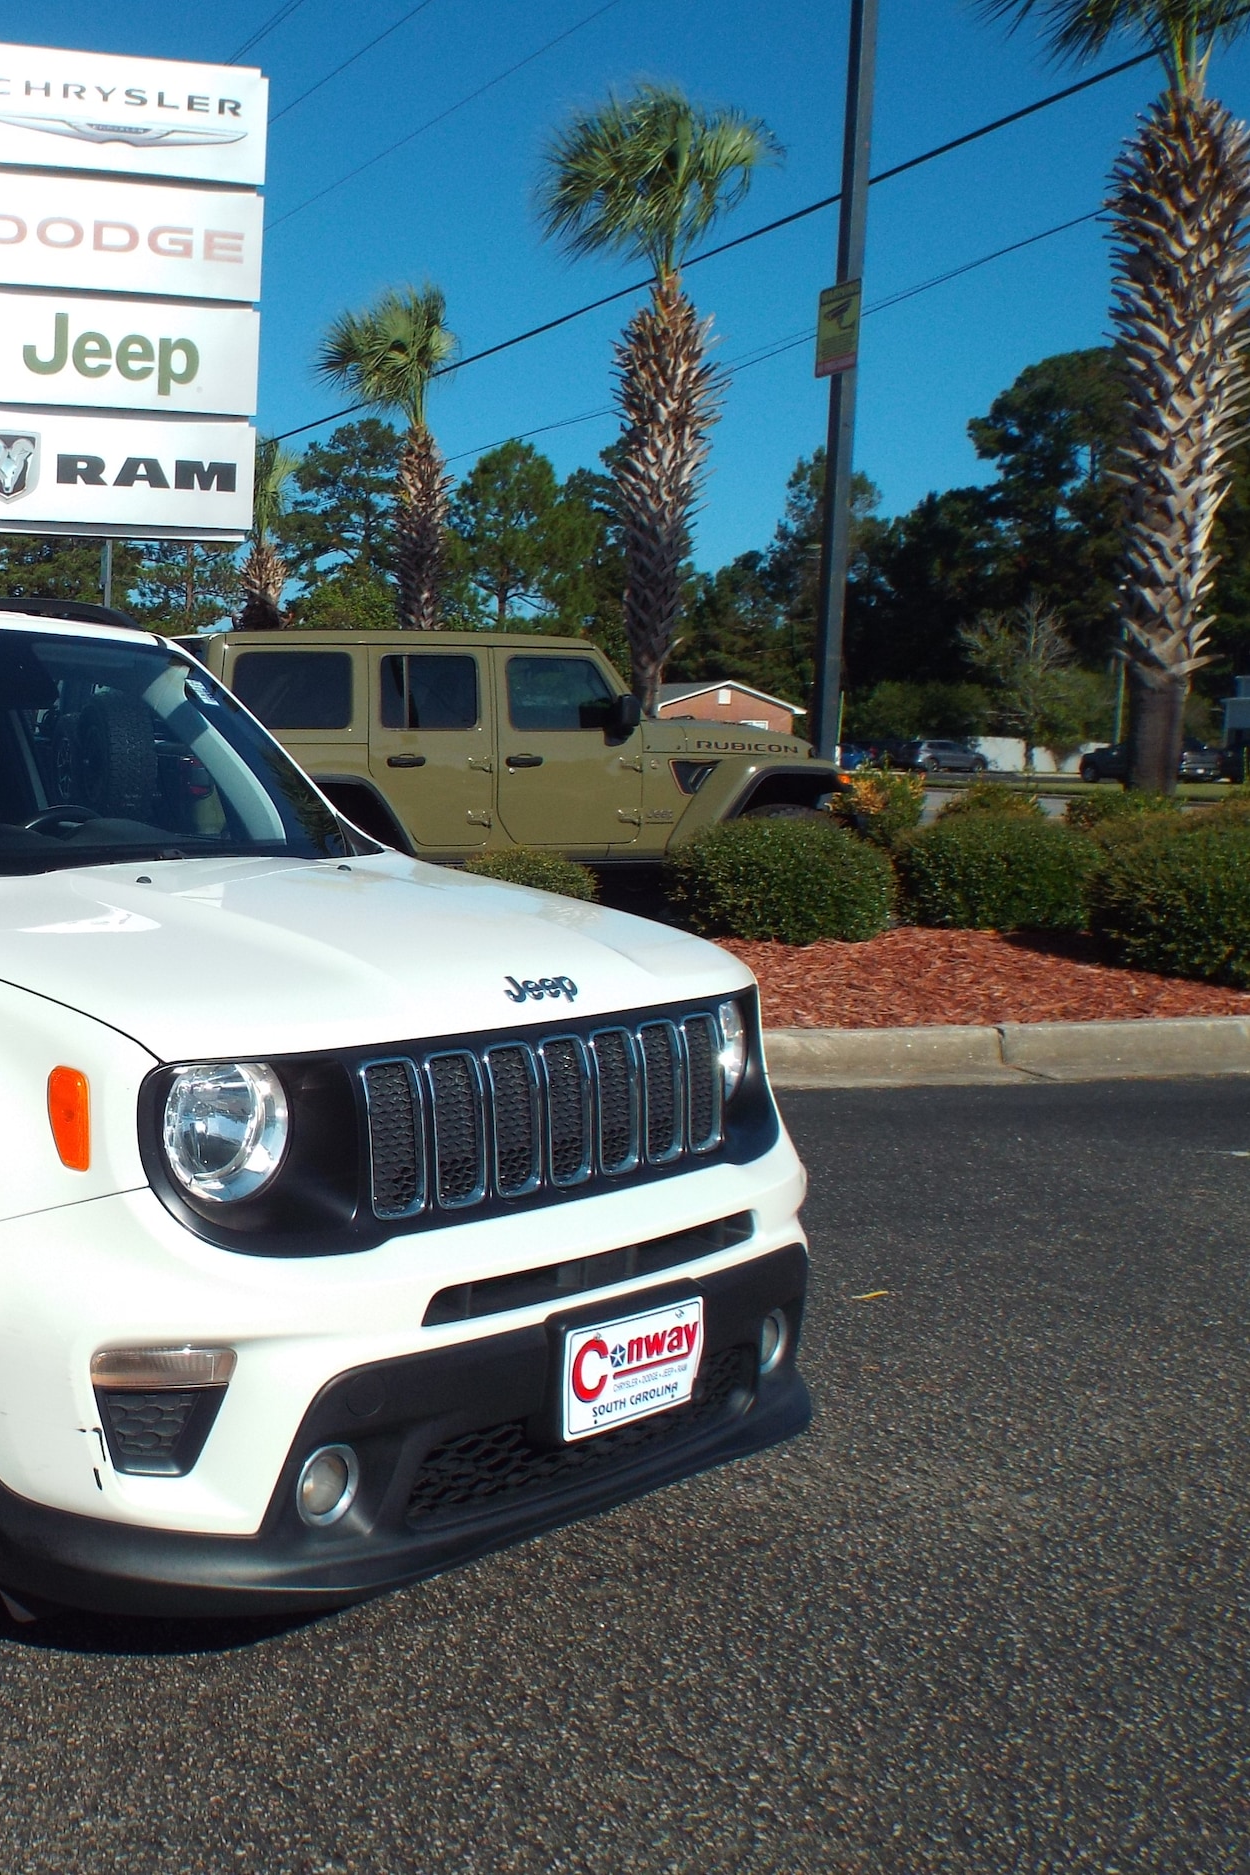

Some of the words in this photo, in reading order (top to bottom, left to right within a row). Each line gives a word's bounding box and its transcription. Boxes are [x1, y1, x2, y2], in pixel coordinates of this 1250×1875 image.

[23, 312, 200, 396] Jeep
[56, 453, 237, 492] RAM
[696, 740, 798, 754] RUBICON
[503, 975, 578, 1003] Jeep
[592, 1397, 626, 1418] SOUTH
[629, 1381, 679, 1406] CAROLINA
